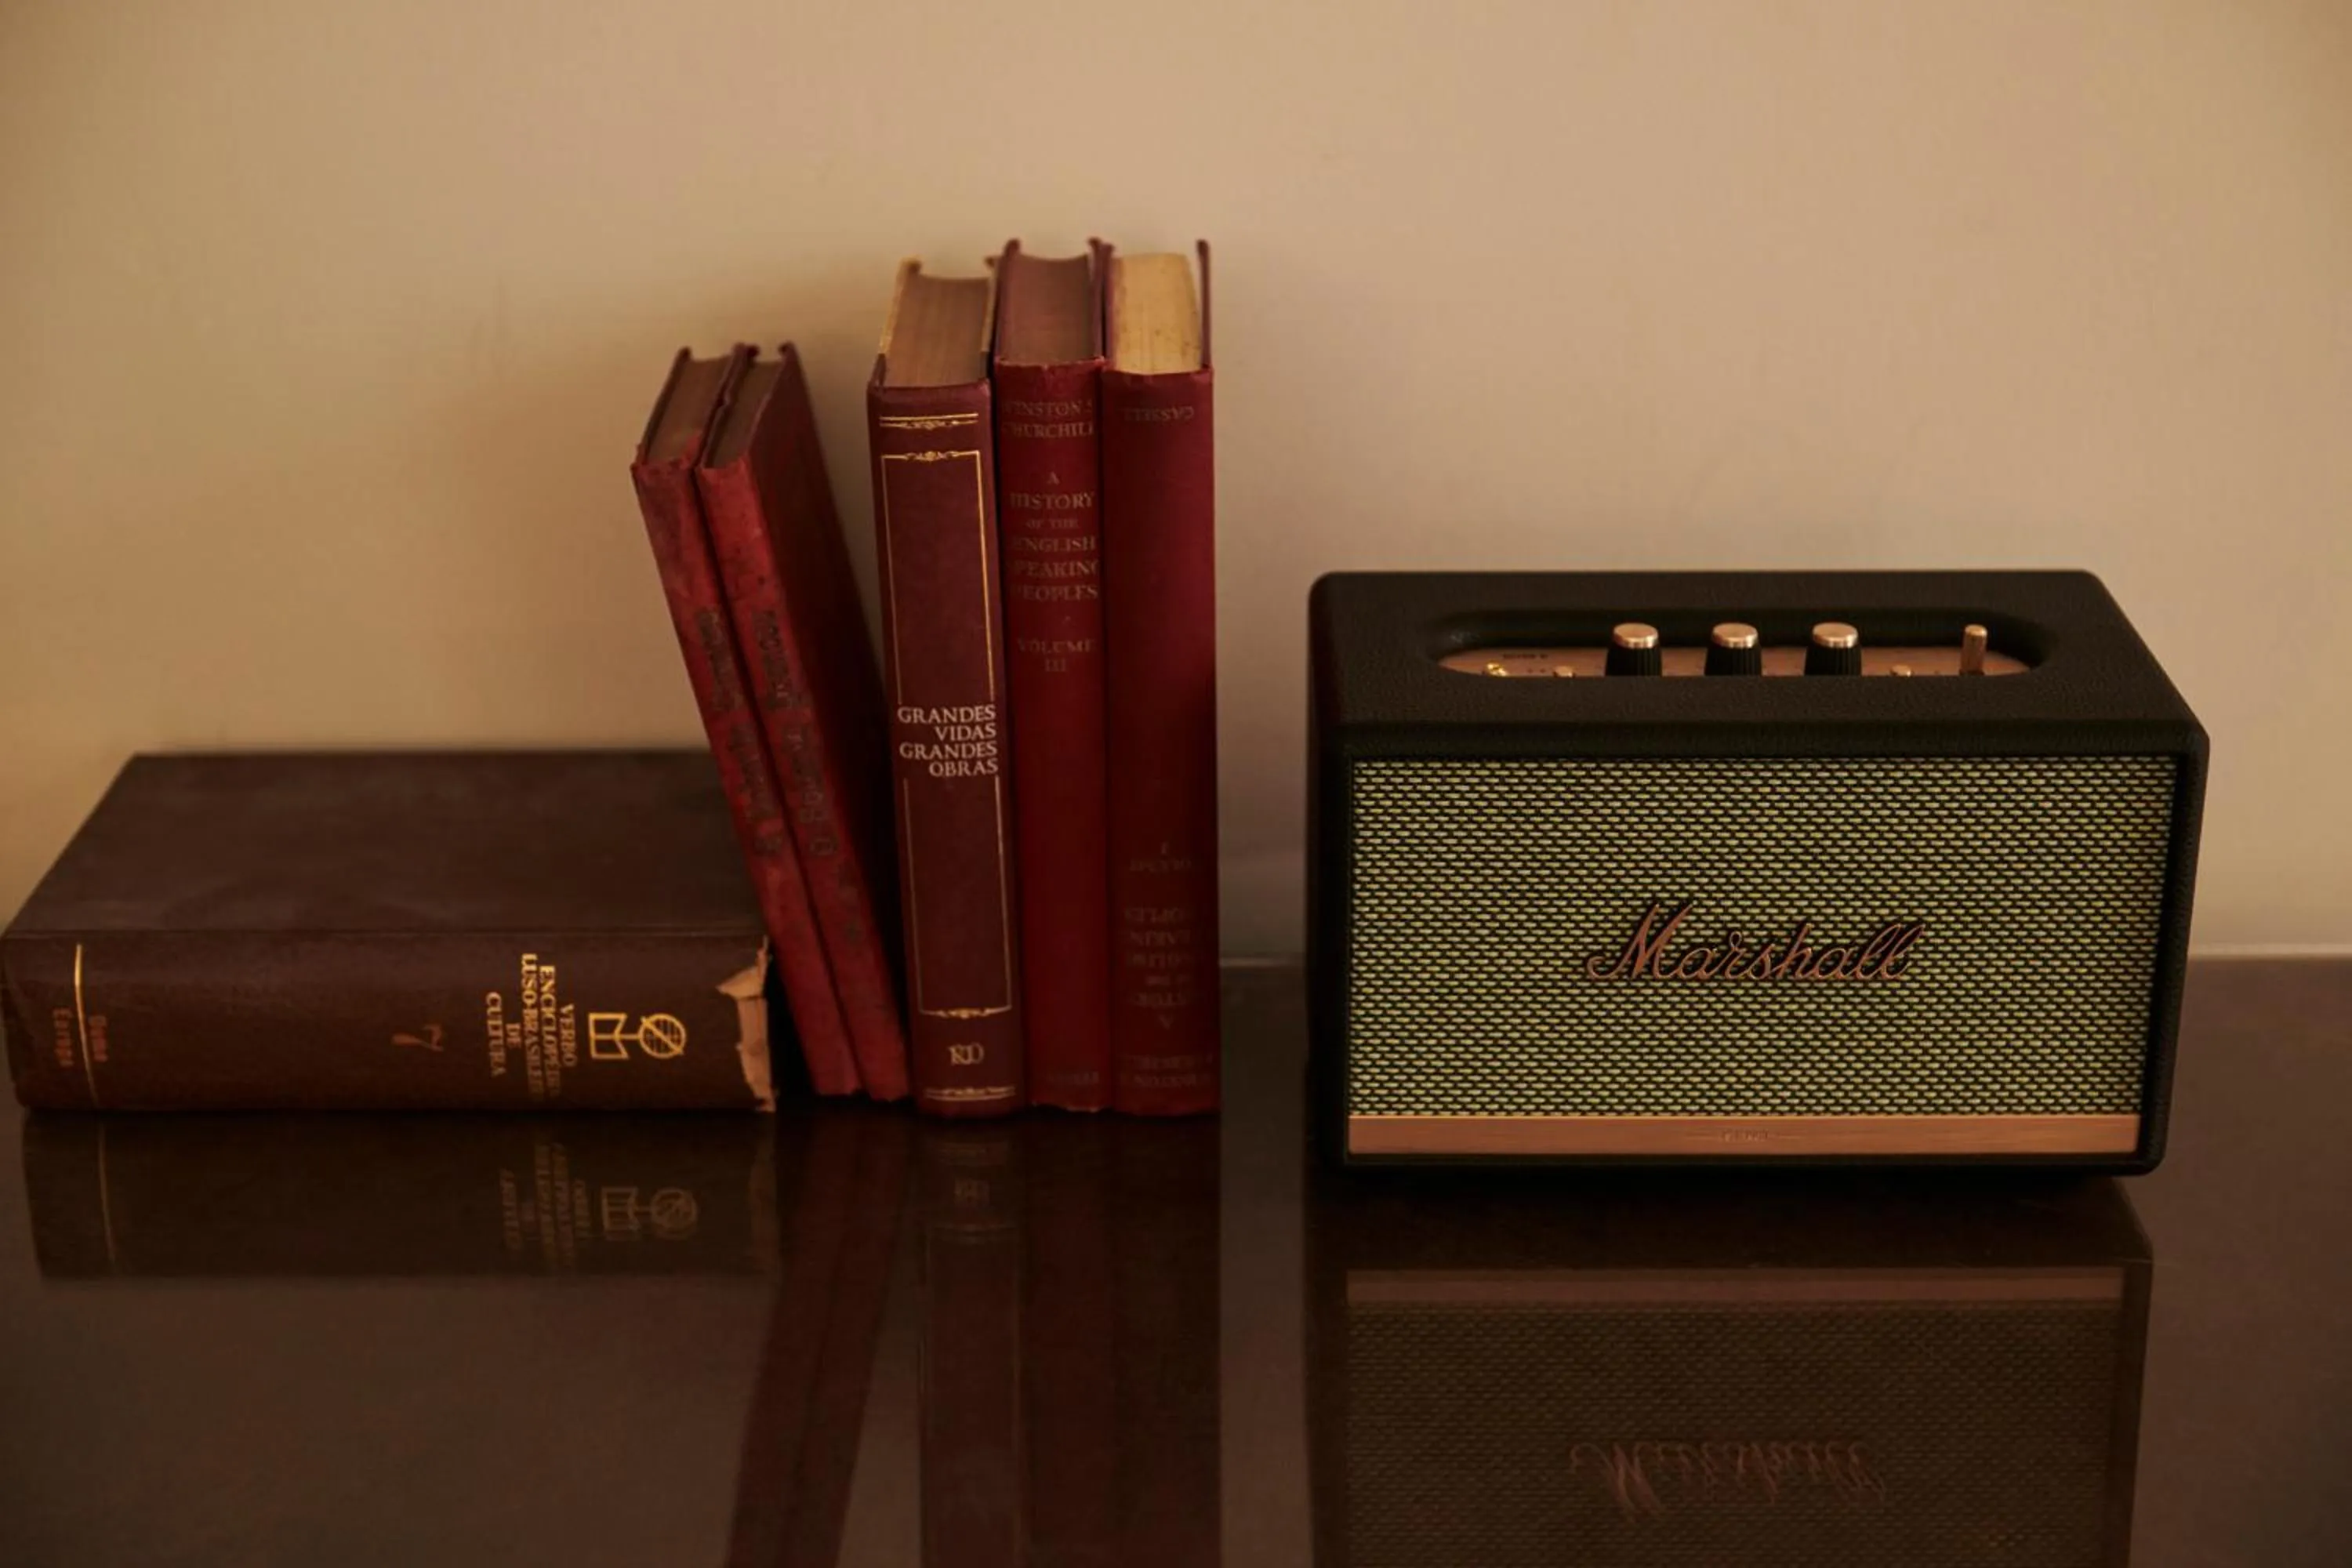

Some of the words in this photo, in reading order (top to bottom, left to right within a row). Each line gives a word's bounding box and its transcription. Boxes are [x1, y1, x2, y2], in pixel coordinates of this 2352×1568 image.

[1046, 471, 1061, 486] A
[1009, 491, 1098, 510] HISTORY
[897, 704, 996, 724] GRANDES
[933, 722, 998, 742] VIDAS
[898, 740, 999, 761] GRANDES
[928, 757, 1000, 778] OBRAS
[1587, 902, 1926, 981] Marshall
[391, 1022, 445, 1053] 7
[486, 991, 508, 1078] CULTURA
[505, 1022, 523, 1048] DE
[559, 1003, 579, 1068] VERBO
